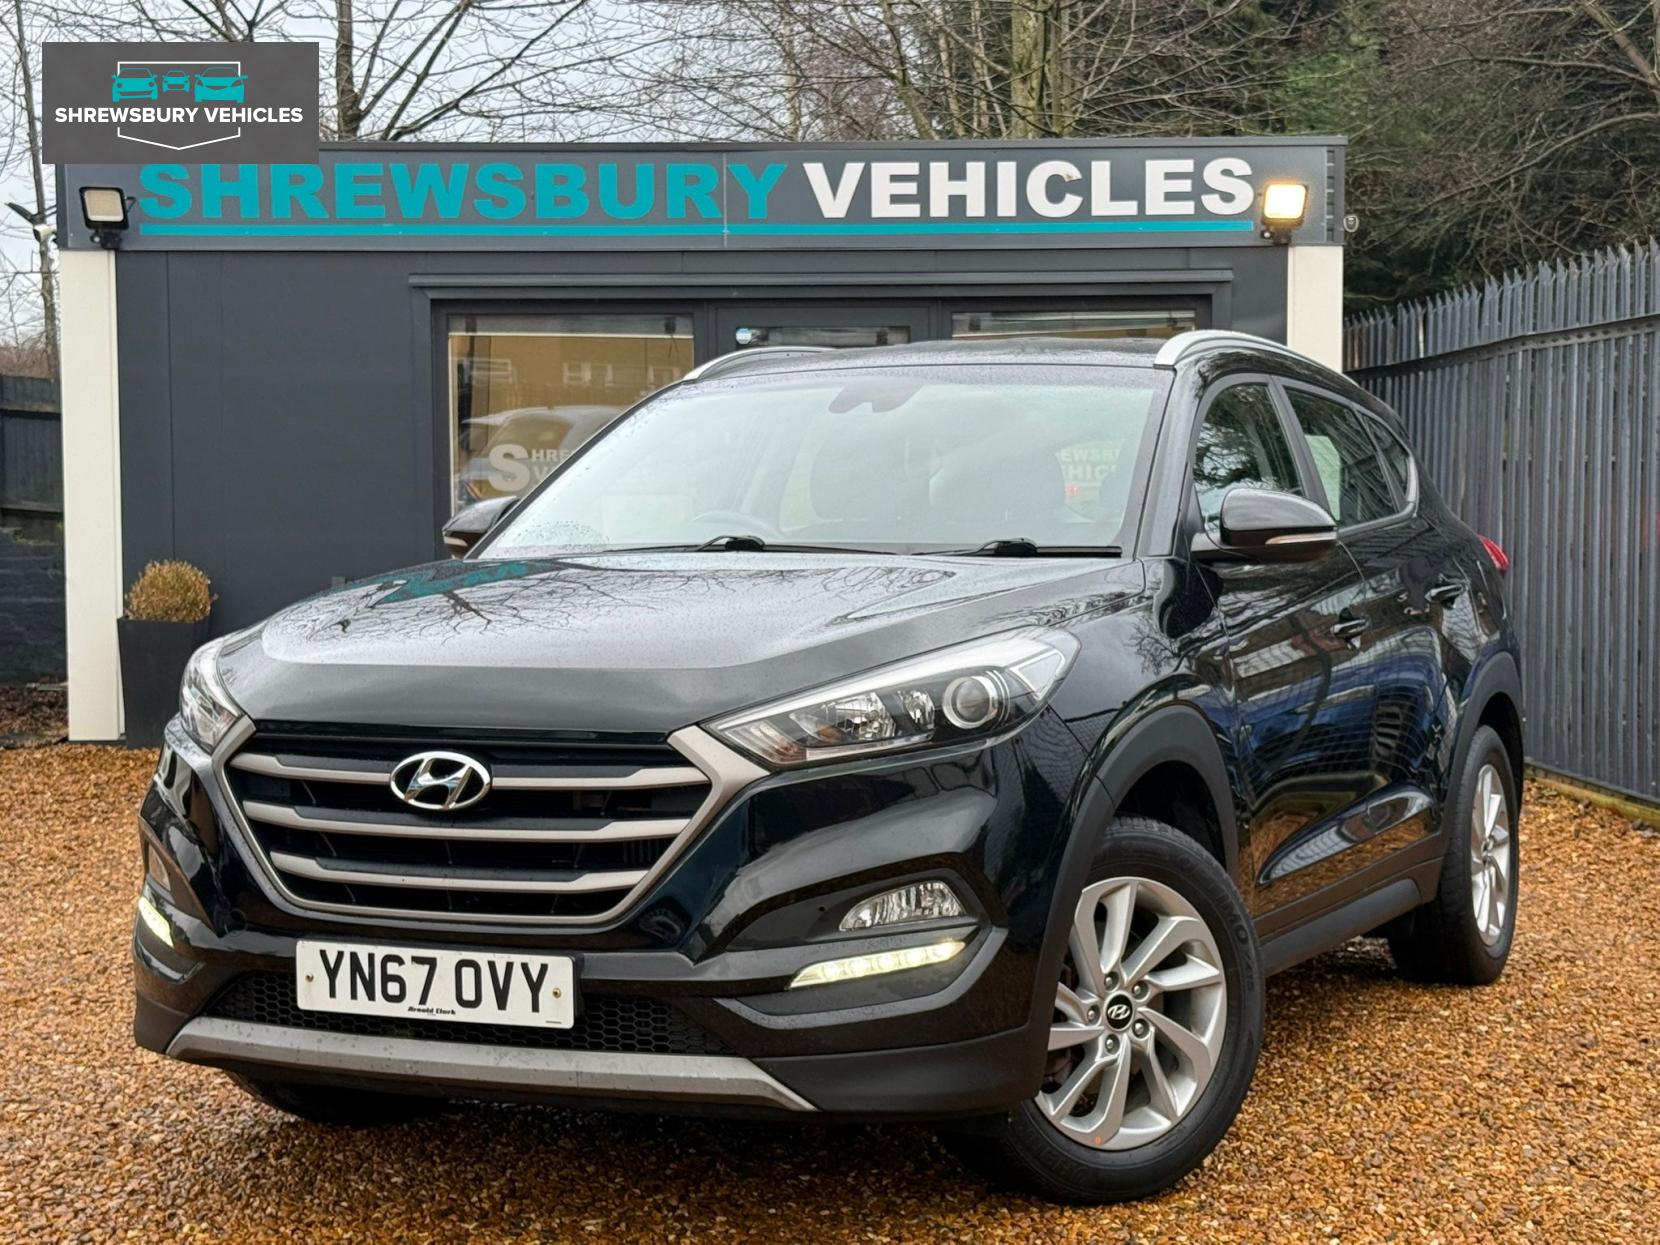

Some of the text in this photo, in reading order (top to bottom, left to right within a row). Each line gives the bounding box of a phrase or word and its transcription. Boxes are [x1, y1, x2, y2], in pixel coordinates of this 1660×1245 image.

[138, 157, 1255, 220] SHREWSBURY VEHICLES
[319, 949, 549, 1013] YN67 OVY
[408, 1006, 433, 1014] Arnold
